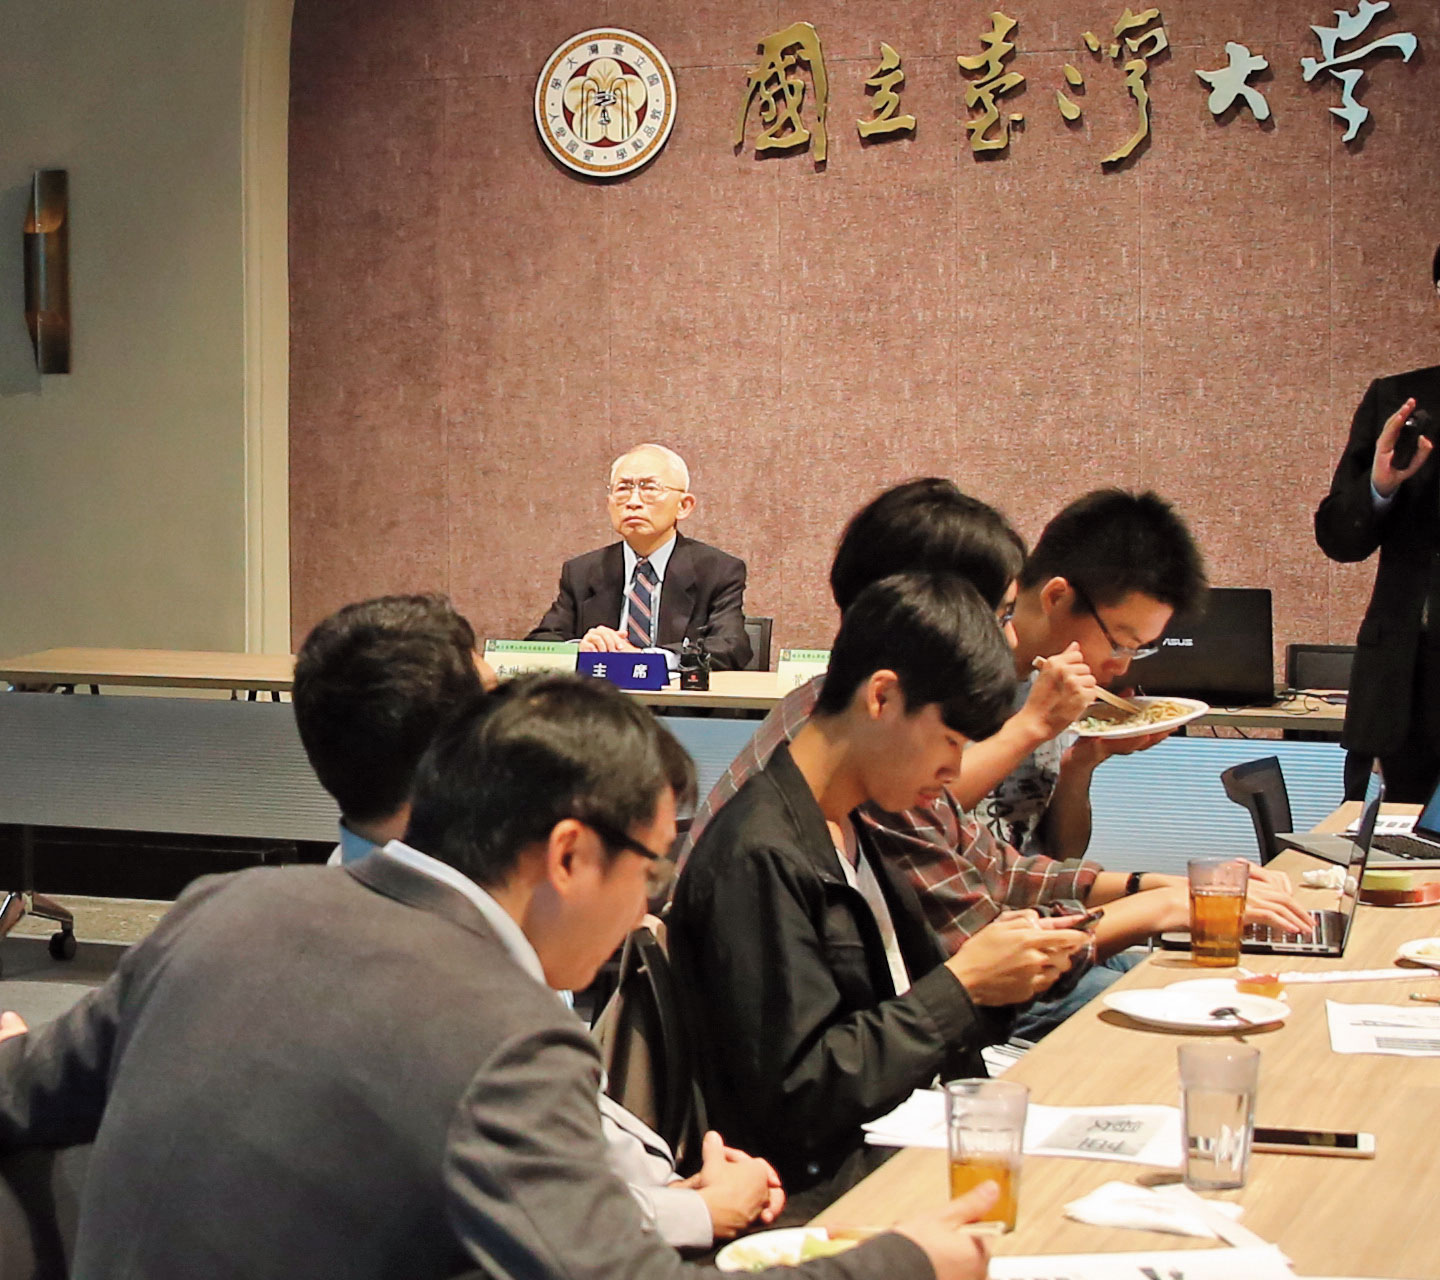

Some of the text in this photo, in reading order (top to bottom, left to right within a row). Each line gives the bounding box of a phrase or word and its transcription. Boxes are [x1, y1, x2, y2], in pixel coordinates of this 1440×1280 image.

[551, 43, 661, 90] 國立臺灣大學
[1162, 638, 1194, 647] ASUS
[592, 662, 649, 679] 主席
